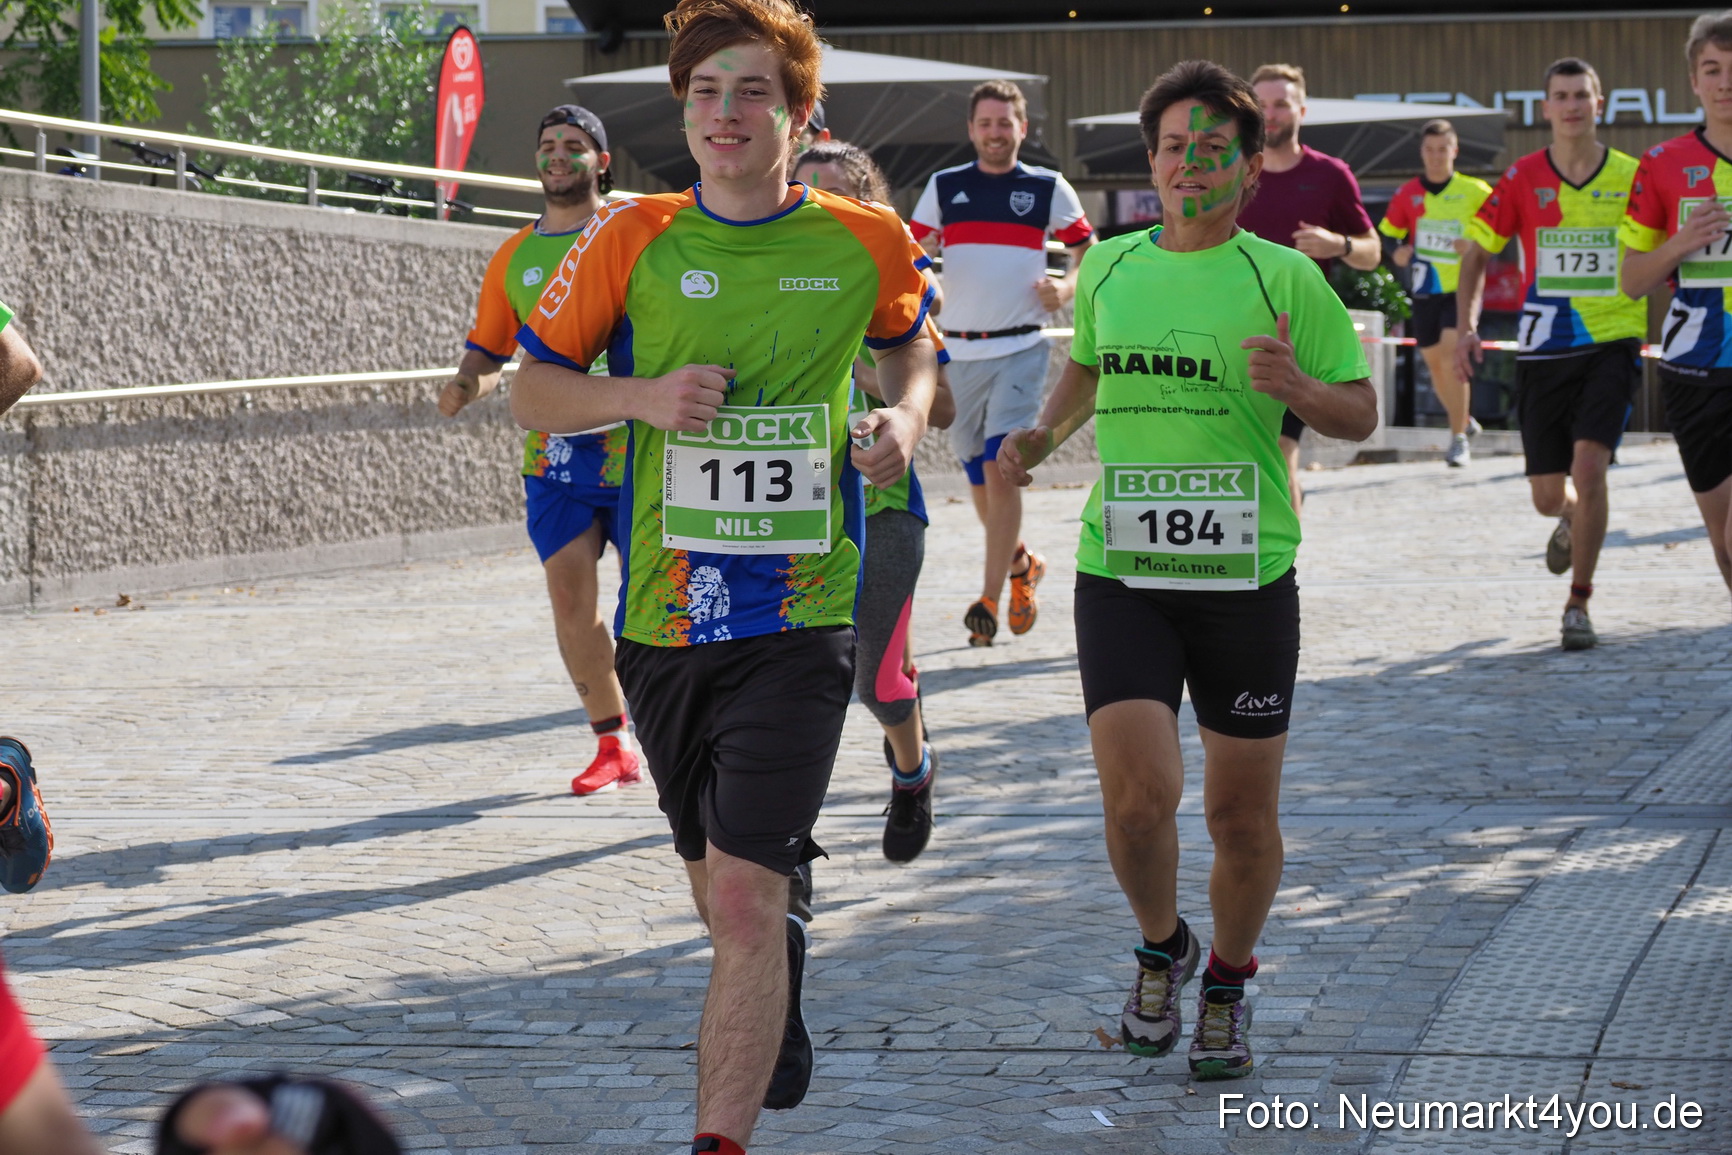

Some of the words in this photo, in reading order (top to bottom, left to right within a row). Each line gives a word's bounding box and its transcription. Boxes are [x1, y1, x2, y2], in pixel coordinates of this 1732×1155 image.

[1542, 231, 1611, 246] BOCK
[1555, 252, 1600, 273] 173
[780, 277, 840, 291] BOCK
[1523, 311, 1543, 346] 7
[1097, 353, 1218, 382] RANDL
[699, 458, 793, 503] 113
[1114, 469, 1245, 497] BOCK
[715, 517, 774, 536] NILS
[1137, 508, 1225, 546] 184
[1134, 556, 1228, 575] Marianne
[1234, 691, 1285, 709] live
